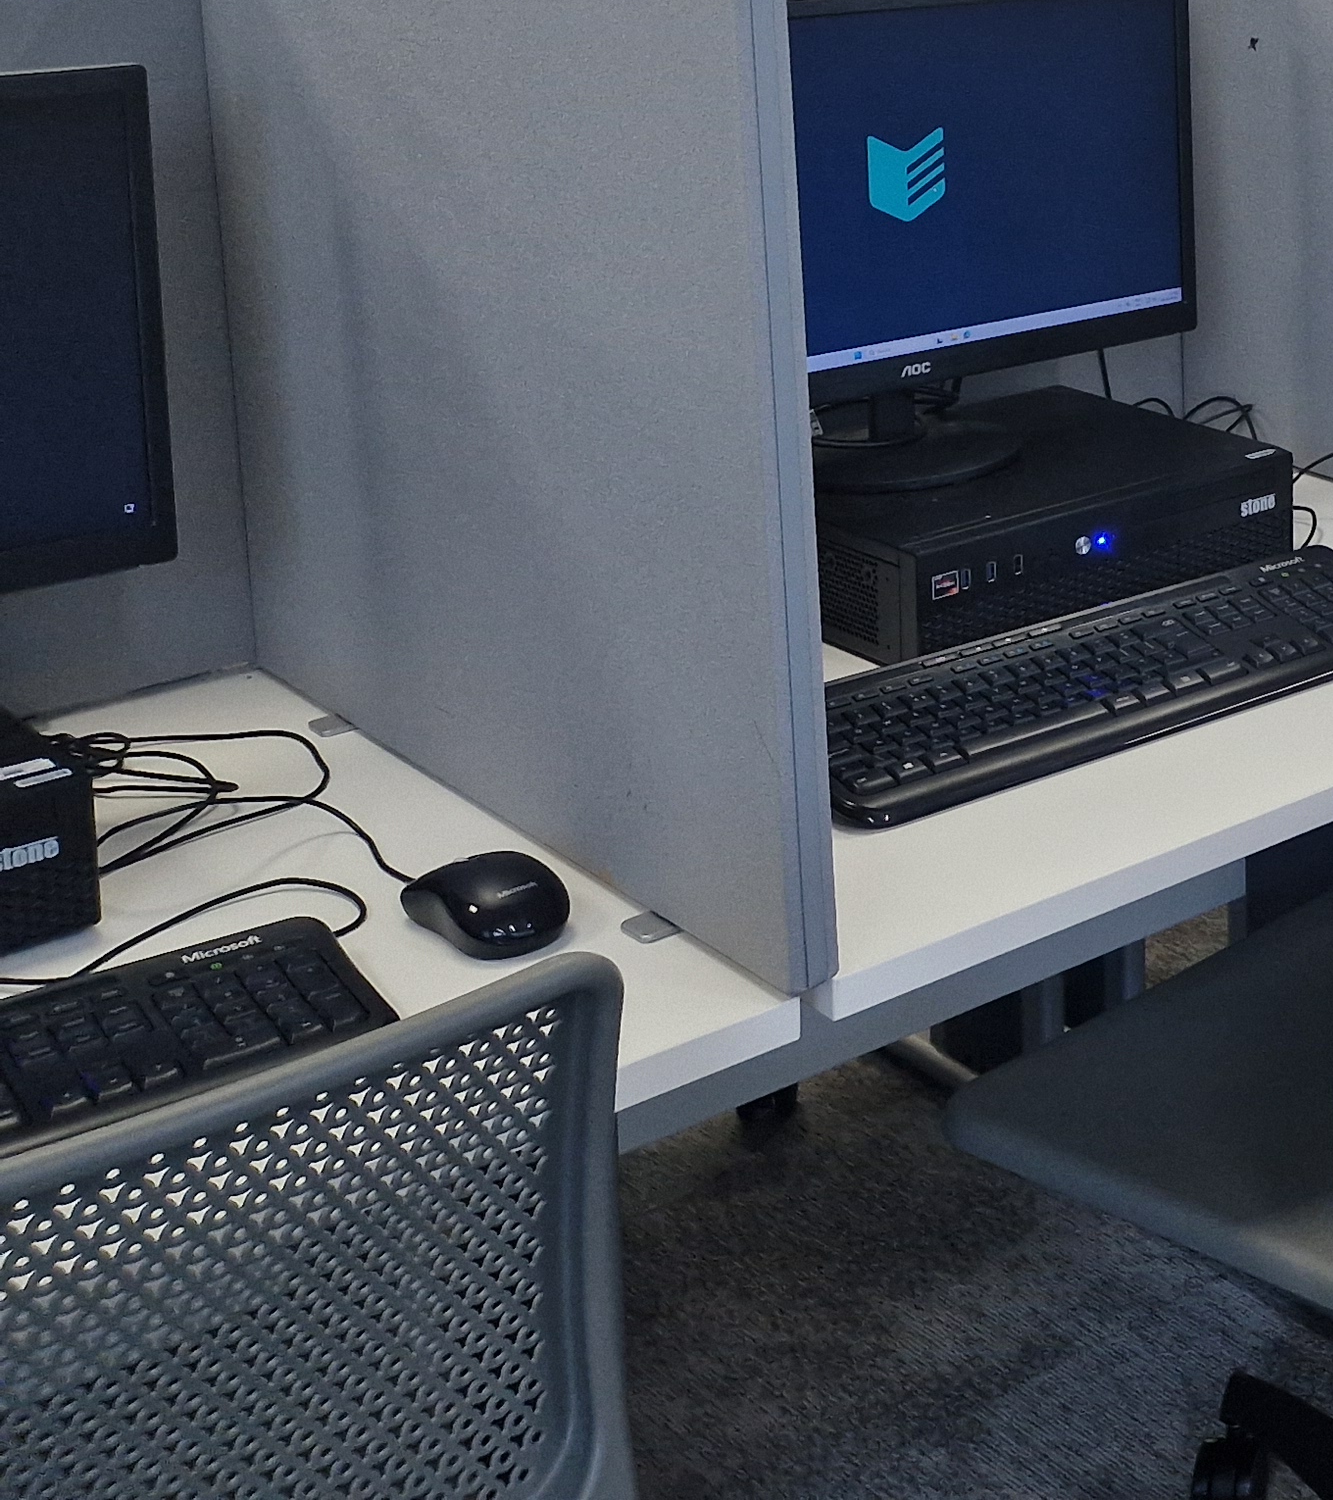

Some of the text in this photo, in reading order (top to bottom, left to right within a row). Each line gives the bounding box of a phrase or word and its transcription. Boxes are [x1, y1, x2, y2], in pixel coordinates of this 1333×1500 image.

[900, 361, 932, 378] AOC
[1259, 556, 1306, 573] Microsoft
[0, 836, 60, 872] tone
[181, 935, 263, 964] Microsoft
